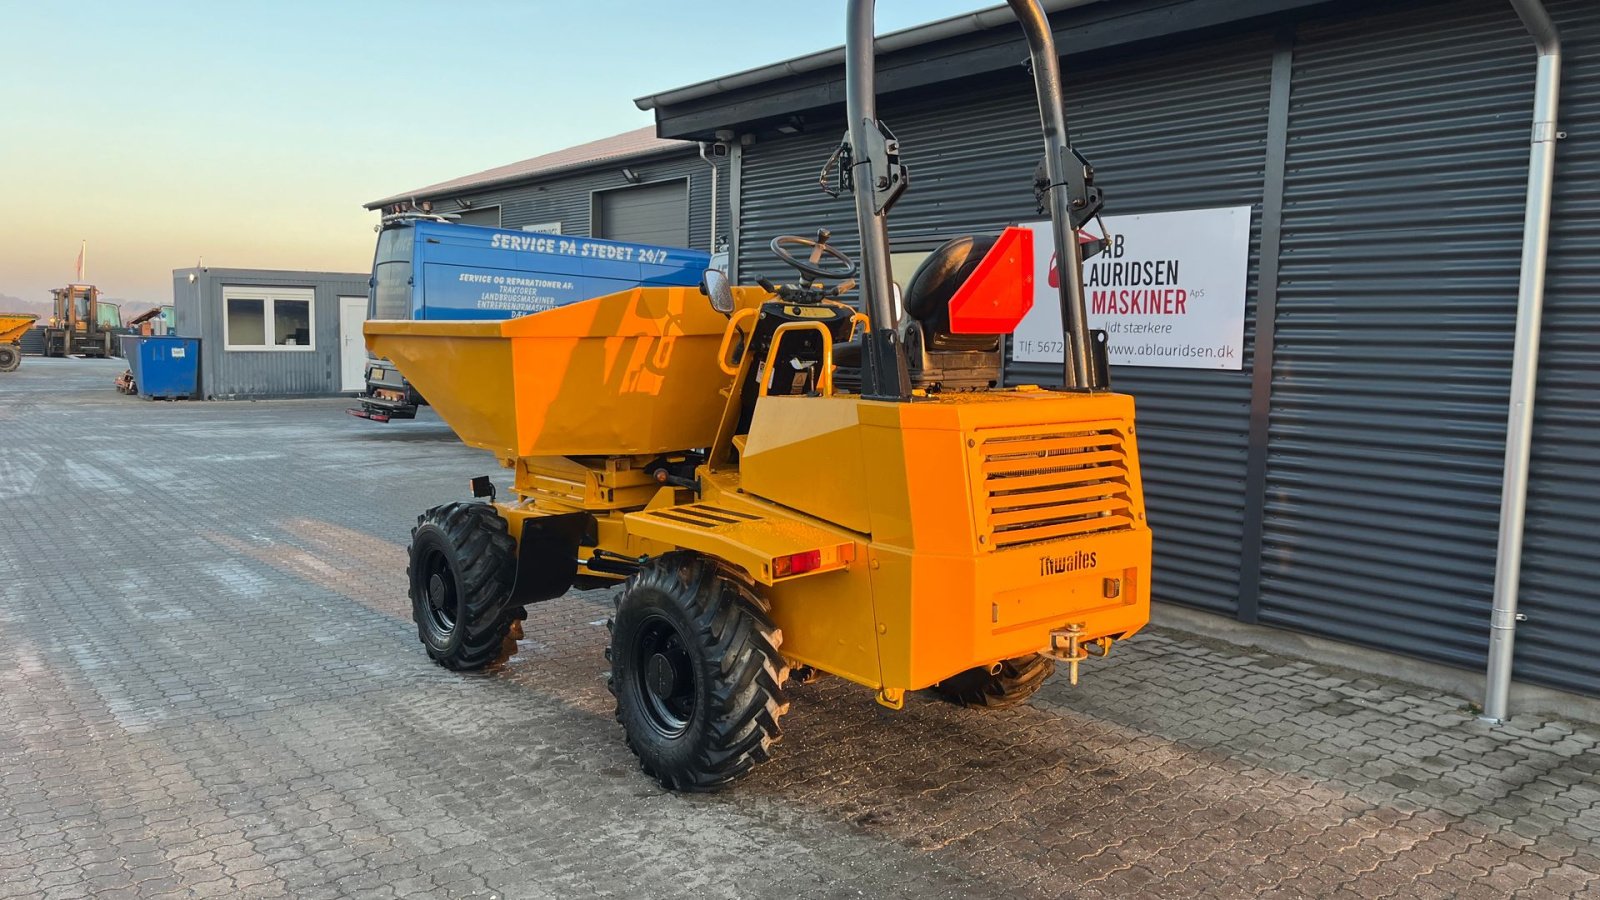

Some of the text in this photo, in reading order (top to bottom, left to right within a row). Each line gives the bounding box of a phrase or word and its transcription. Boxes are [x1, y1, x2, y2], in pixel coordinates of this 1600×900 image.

[491, 233, 555, 253] SERVICE
[581, 243, 633, 261] STEDET
[638, 249, 668, 264] 24/7
[1102, 234, 1125, 259] AB
[459, 273, 492, 284] SERVICE
[493, 276, 504, 285] OG
[506, 277, 562, 289] REPARATIONER
[499, 285, 538, 296] TRAKTORER
[481, 292, 555, 305] LANDBRUGSMASKINER
[1092, 289, 1205, 315] MASKINER ApS
[477, 300, 560, 312] ENTREPRENØRMASKIN
[1104, 321, 1172, 334] lidt stærkere
[1019, 341, 1034, 354] Tlf.
[1037, 341, 1063, 353] 5672
[1040, 550, 1097, 577] Thwaites
